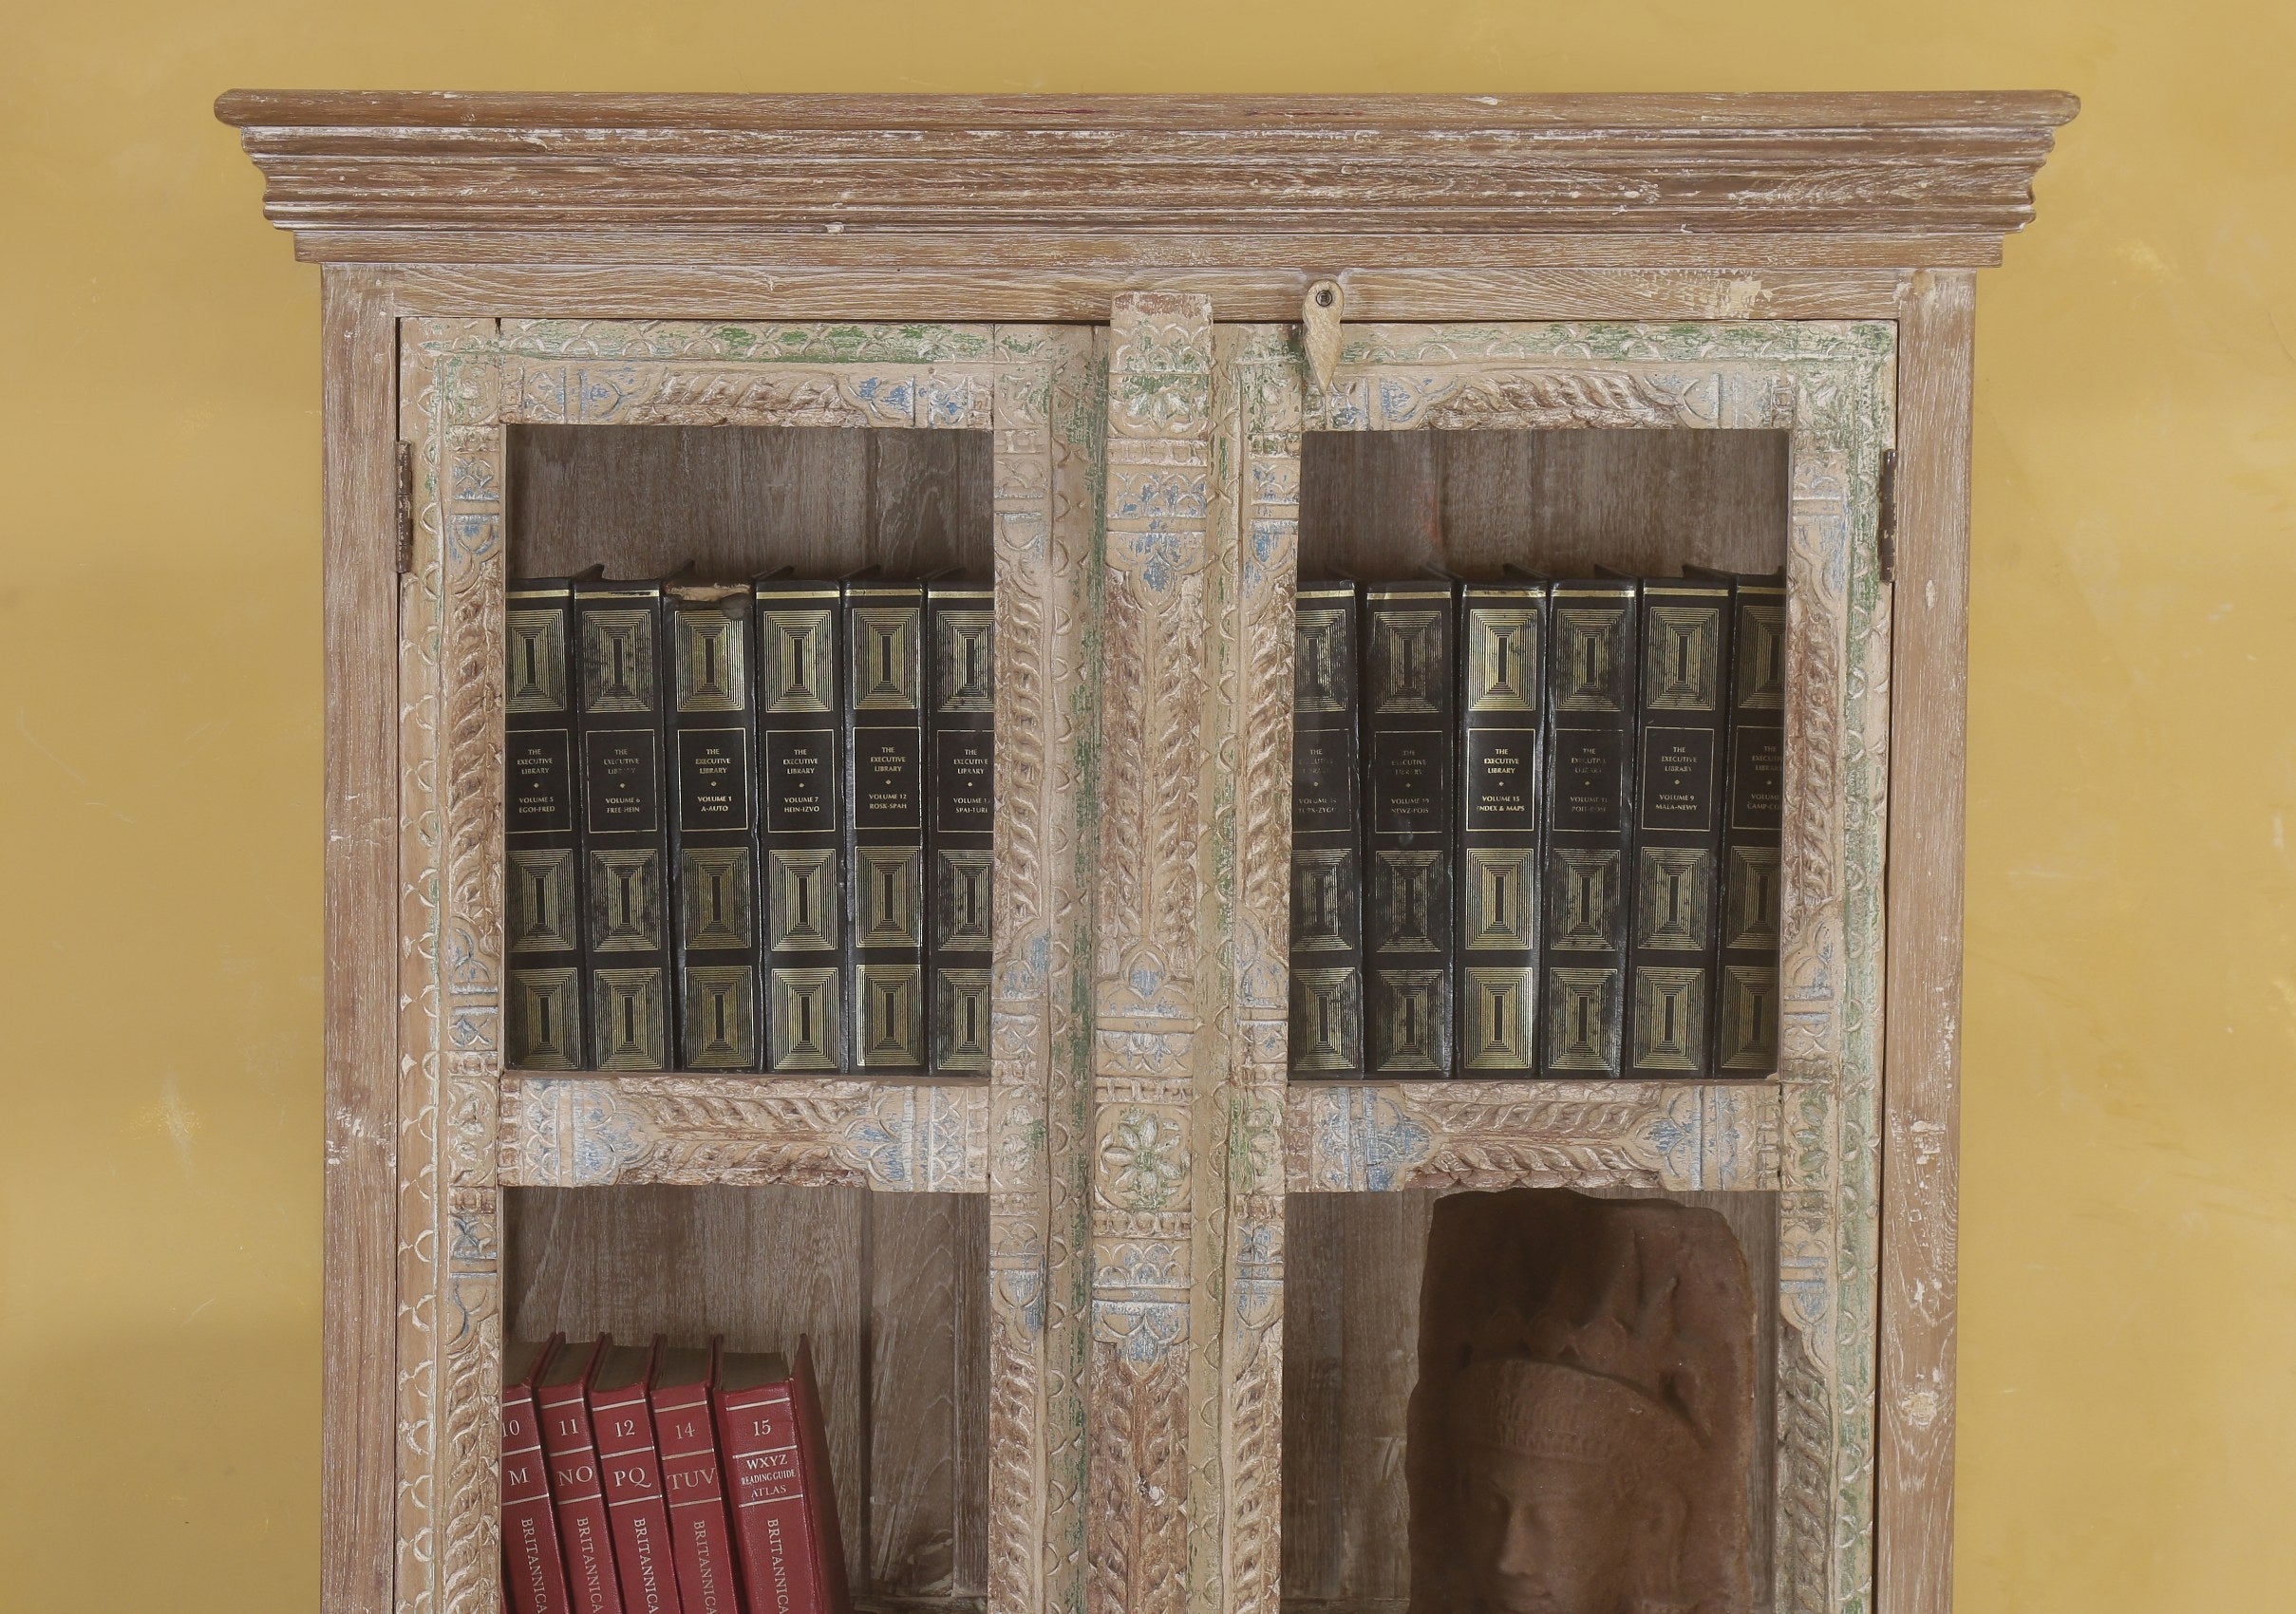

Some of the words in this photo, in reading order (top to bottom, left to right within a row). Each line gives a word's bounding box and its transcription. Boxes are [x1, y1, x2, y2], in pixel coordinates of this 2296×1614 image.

[501, 1419, 520, 1438] 10
[558, 1418, 579, 1436] 11
[614, 1419, 635, 1437] 12
[675, 1421, 696, 1440] 14
[753, 1418, 771, 1436] 15
[745, 1454, 788, 1470] WXYZ
[507, 1466, 530, 1486] M
[556, 1465, 593, 1487] NO
[613, 1467, 651, 1489] PQ
[667, 1467, 717, 1491] TUV
[741, 1473, 773, 1487] READING
[773, 1468, 797, 1481] GUIDE
[751, 1484, 787, 1498] ATLAS
[521, 1517, 548, 1614] BRITANNICA
[576, 1517, 604, 1614] BRITANNICA
[633, 1517, 660, 1614] BRITANNICA
[693, 1519, 718, 1614] BRITANNICA
[767, 1518, 790, 1614] BRITANNICA
